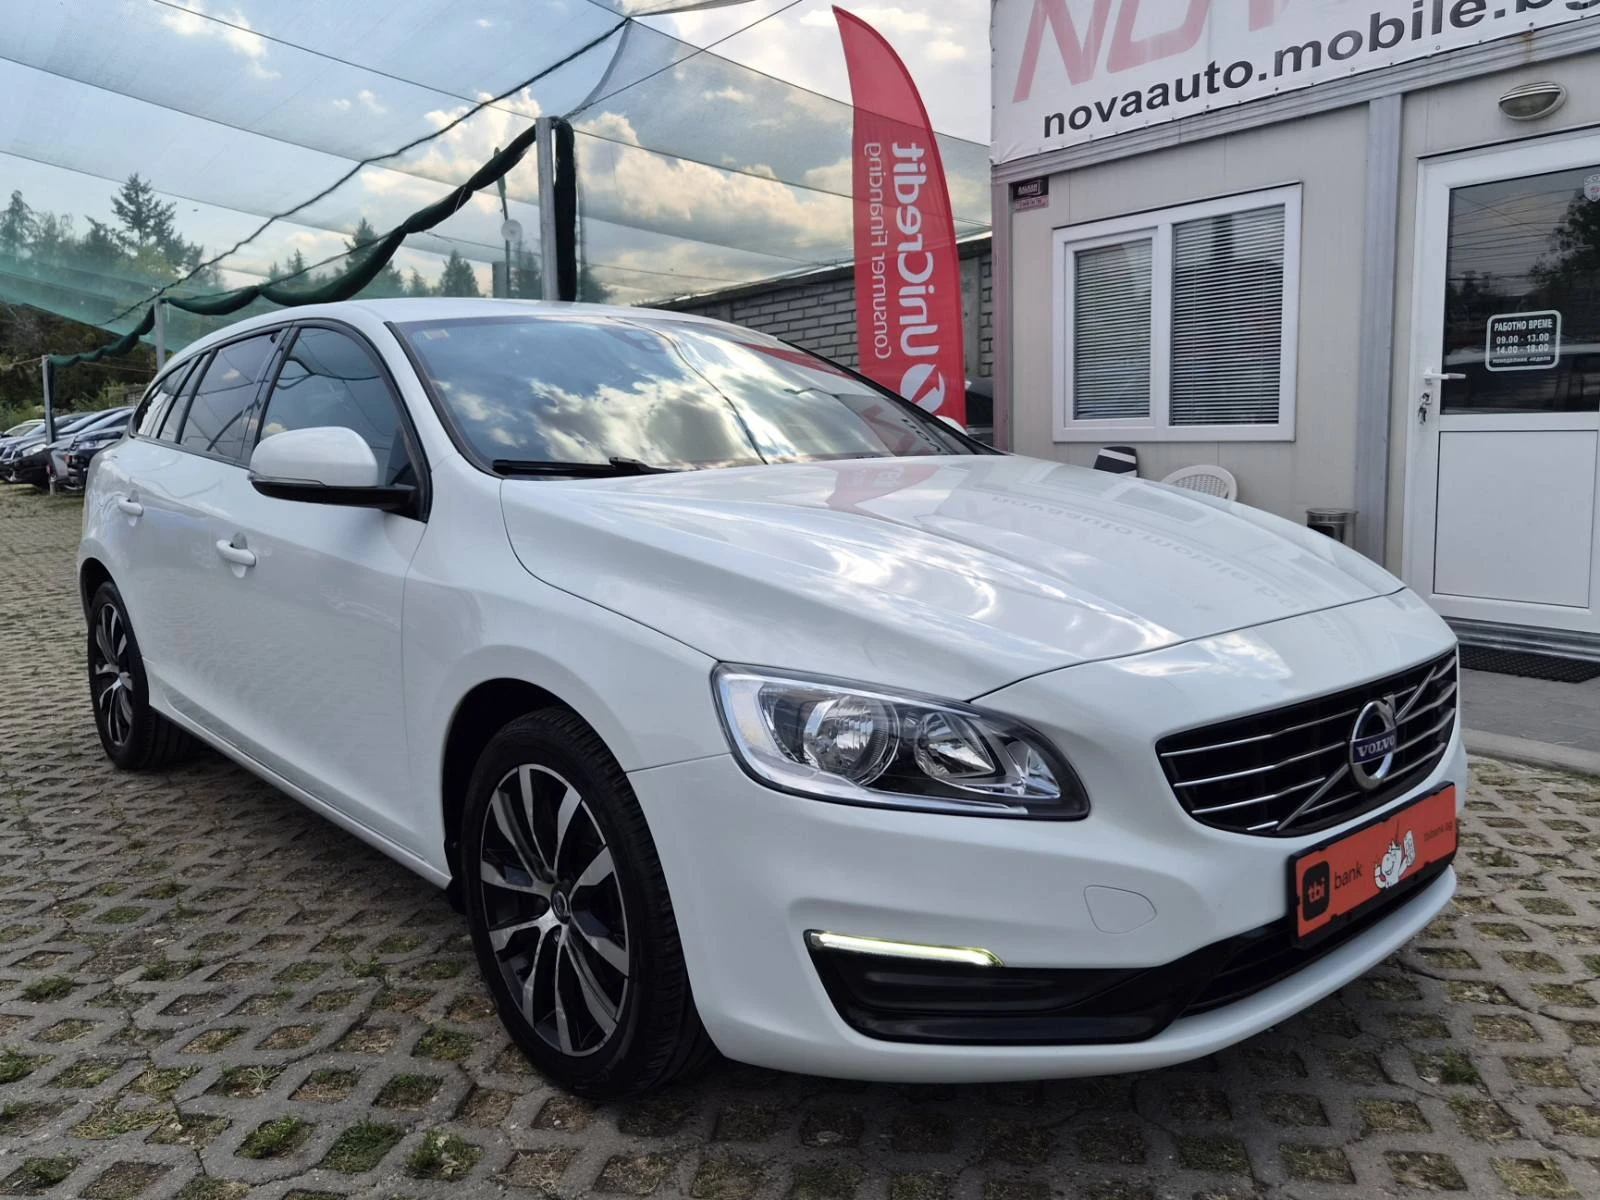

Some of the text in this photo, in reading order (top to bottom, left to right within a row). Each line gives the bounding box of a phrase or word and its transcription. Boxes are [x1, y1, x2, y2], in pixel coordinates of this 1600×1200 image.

[1044, 0, 1600, 137] novaauto.mobile.
[1494, 318, 1553, 332] РАБОТНО ВРЕМЕ
[1496, 335, 1519, 345] 09.00
[1356, 735, 1395, 757] VOLVO
[1308, 862, 1362, 903] tbi bank
